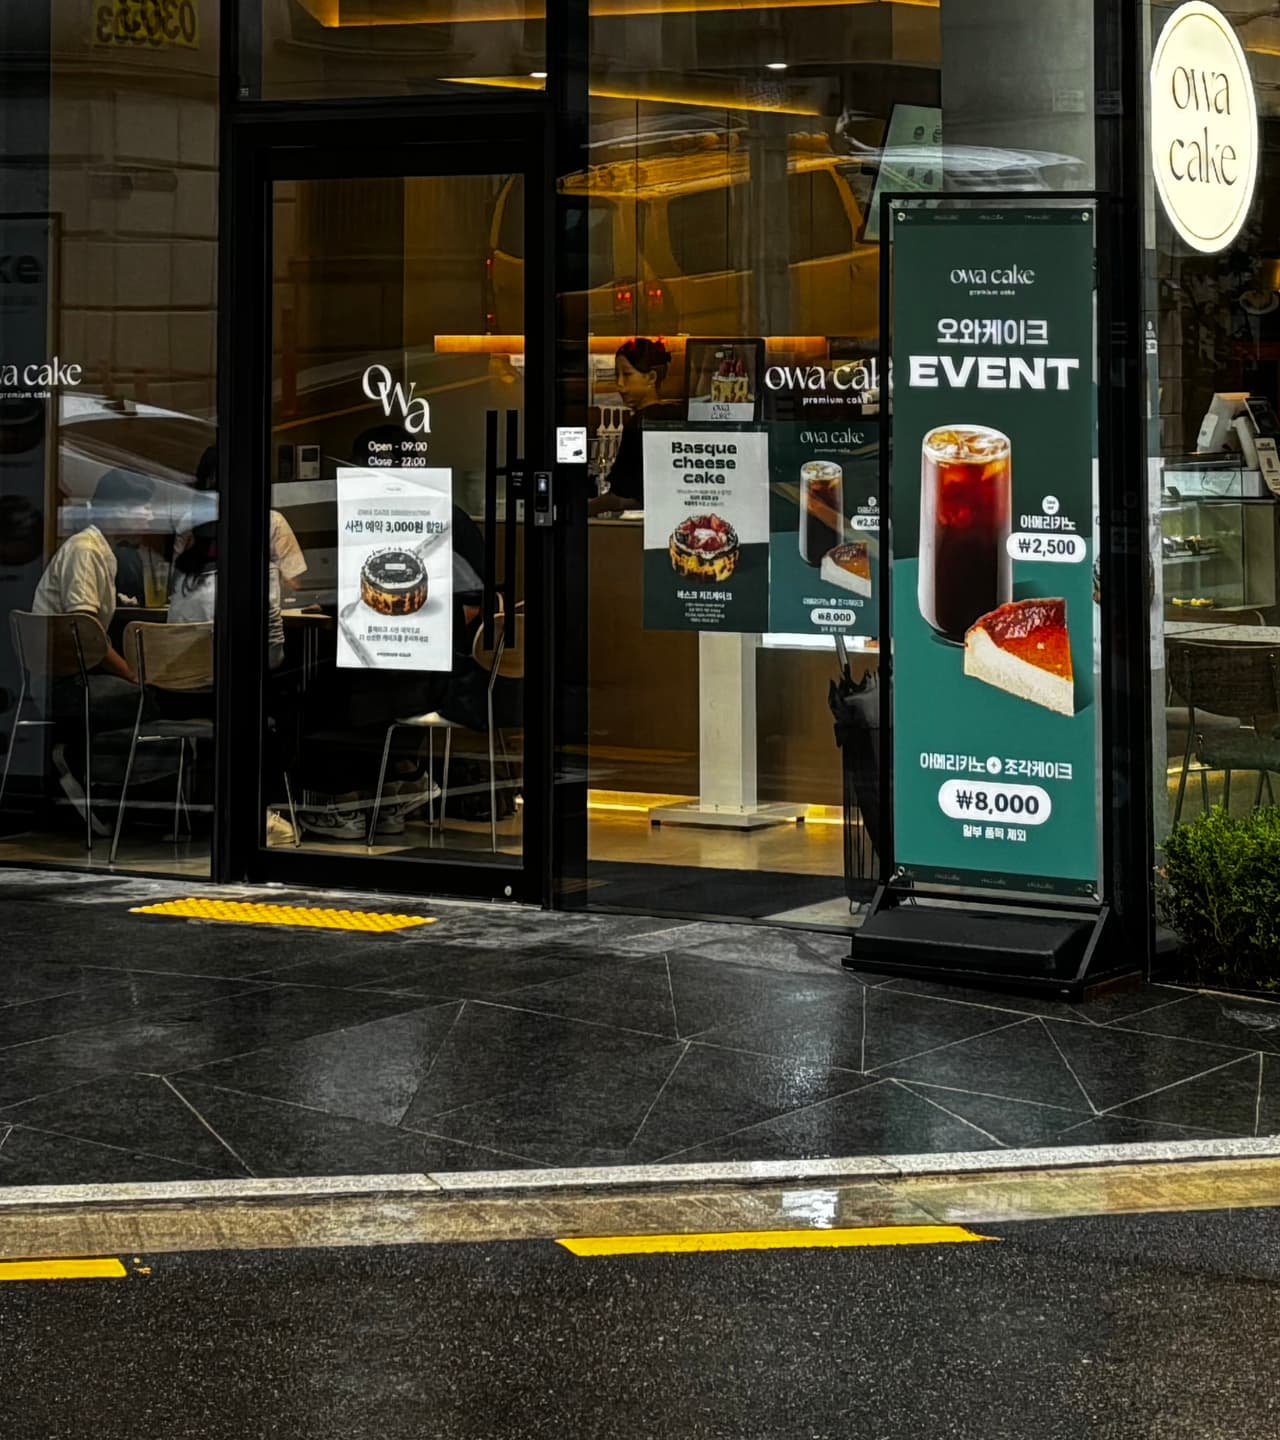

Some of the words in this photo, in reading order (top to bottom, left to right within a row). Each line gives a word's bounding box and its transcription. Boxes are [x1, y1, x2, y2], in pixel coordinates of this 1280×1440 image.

[1172, 66, 1230, 115] owa
[1170, 126, 1237, 186] cake
[950, 268, 987, 285] owa
[991, 264, 1036, 285] cake
[937, 318, 1048, 345] 오와케이크
[23, 356, 82, 386] cake
[765, 366, 826, 390] owa
[909, 355, 1080, 390] EVENT
[803, 396, 843, 406] premium
[800, 431, 828, 443] owa
[831, 427, 864, 444] cake
[368, 441, 393, 453] Open
[671, 441, 737, 455] Basque
[368, 457, 392, 467] Close
[672, 457, 736, 470] cheese
[683, 472, 725, 484] cake
[345, 520, 363, 533] 사전
[365, 520, 383, 533] 예약
[385, 521, 423, 534] 3,000원
[1020, 514, 1076, 531] 아메리카노
[1018, 538, 1076, 557] ₩2,500
[920, 753, 986, 774] 아메리카노
[1005, 759, 1073, 780] 조각케이크
[956, 789, 1040, 816] ₩8,000
[963, 824, 982, 839] 일부
[1007, 828, 1026, 843] 제외
